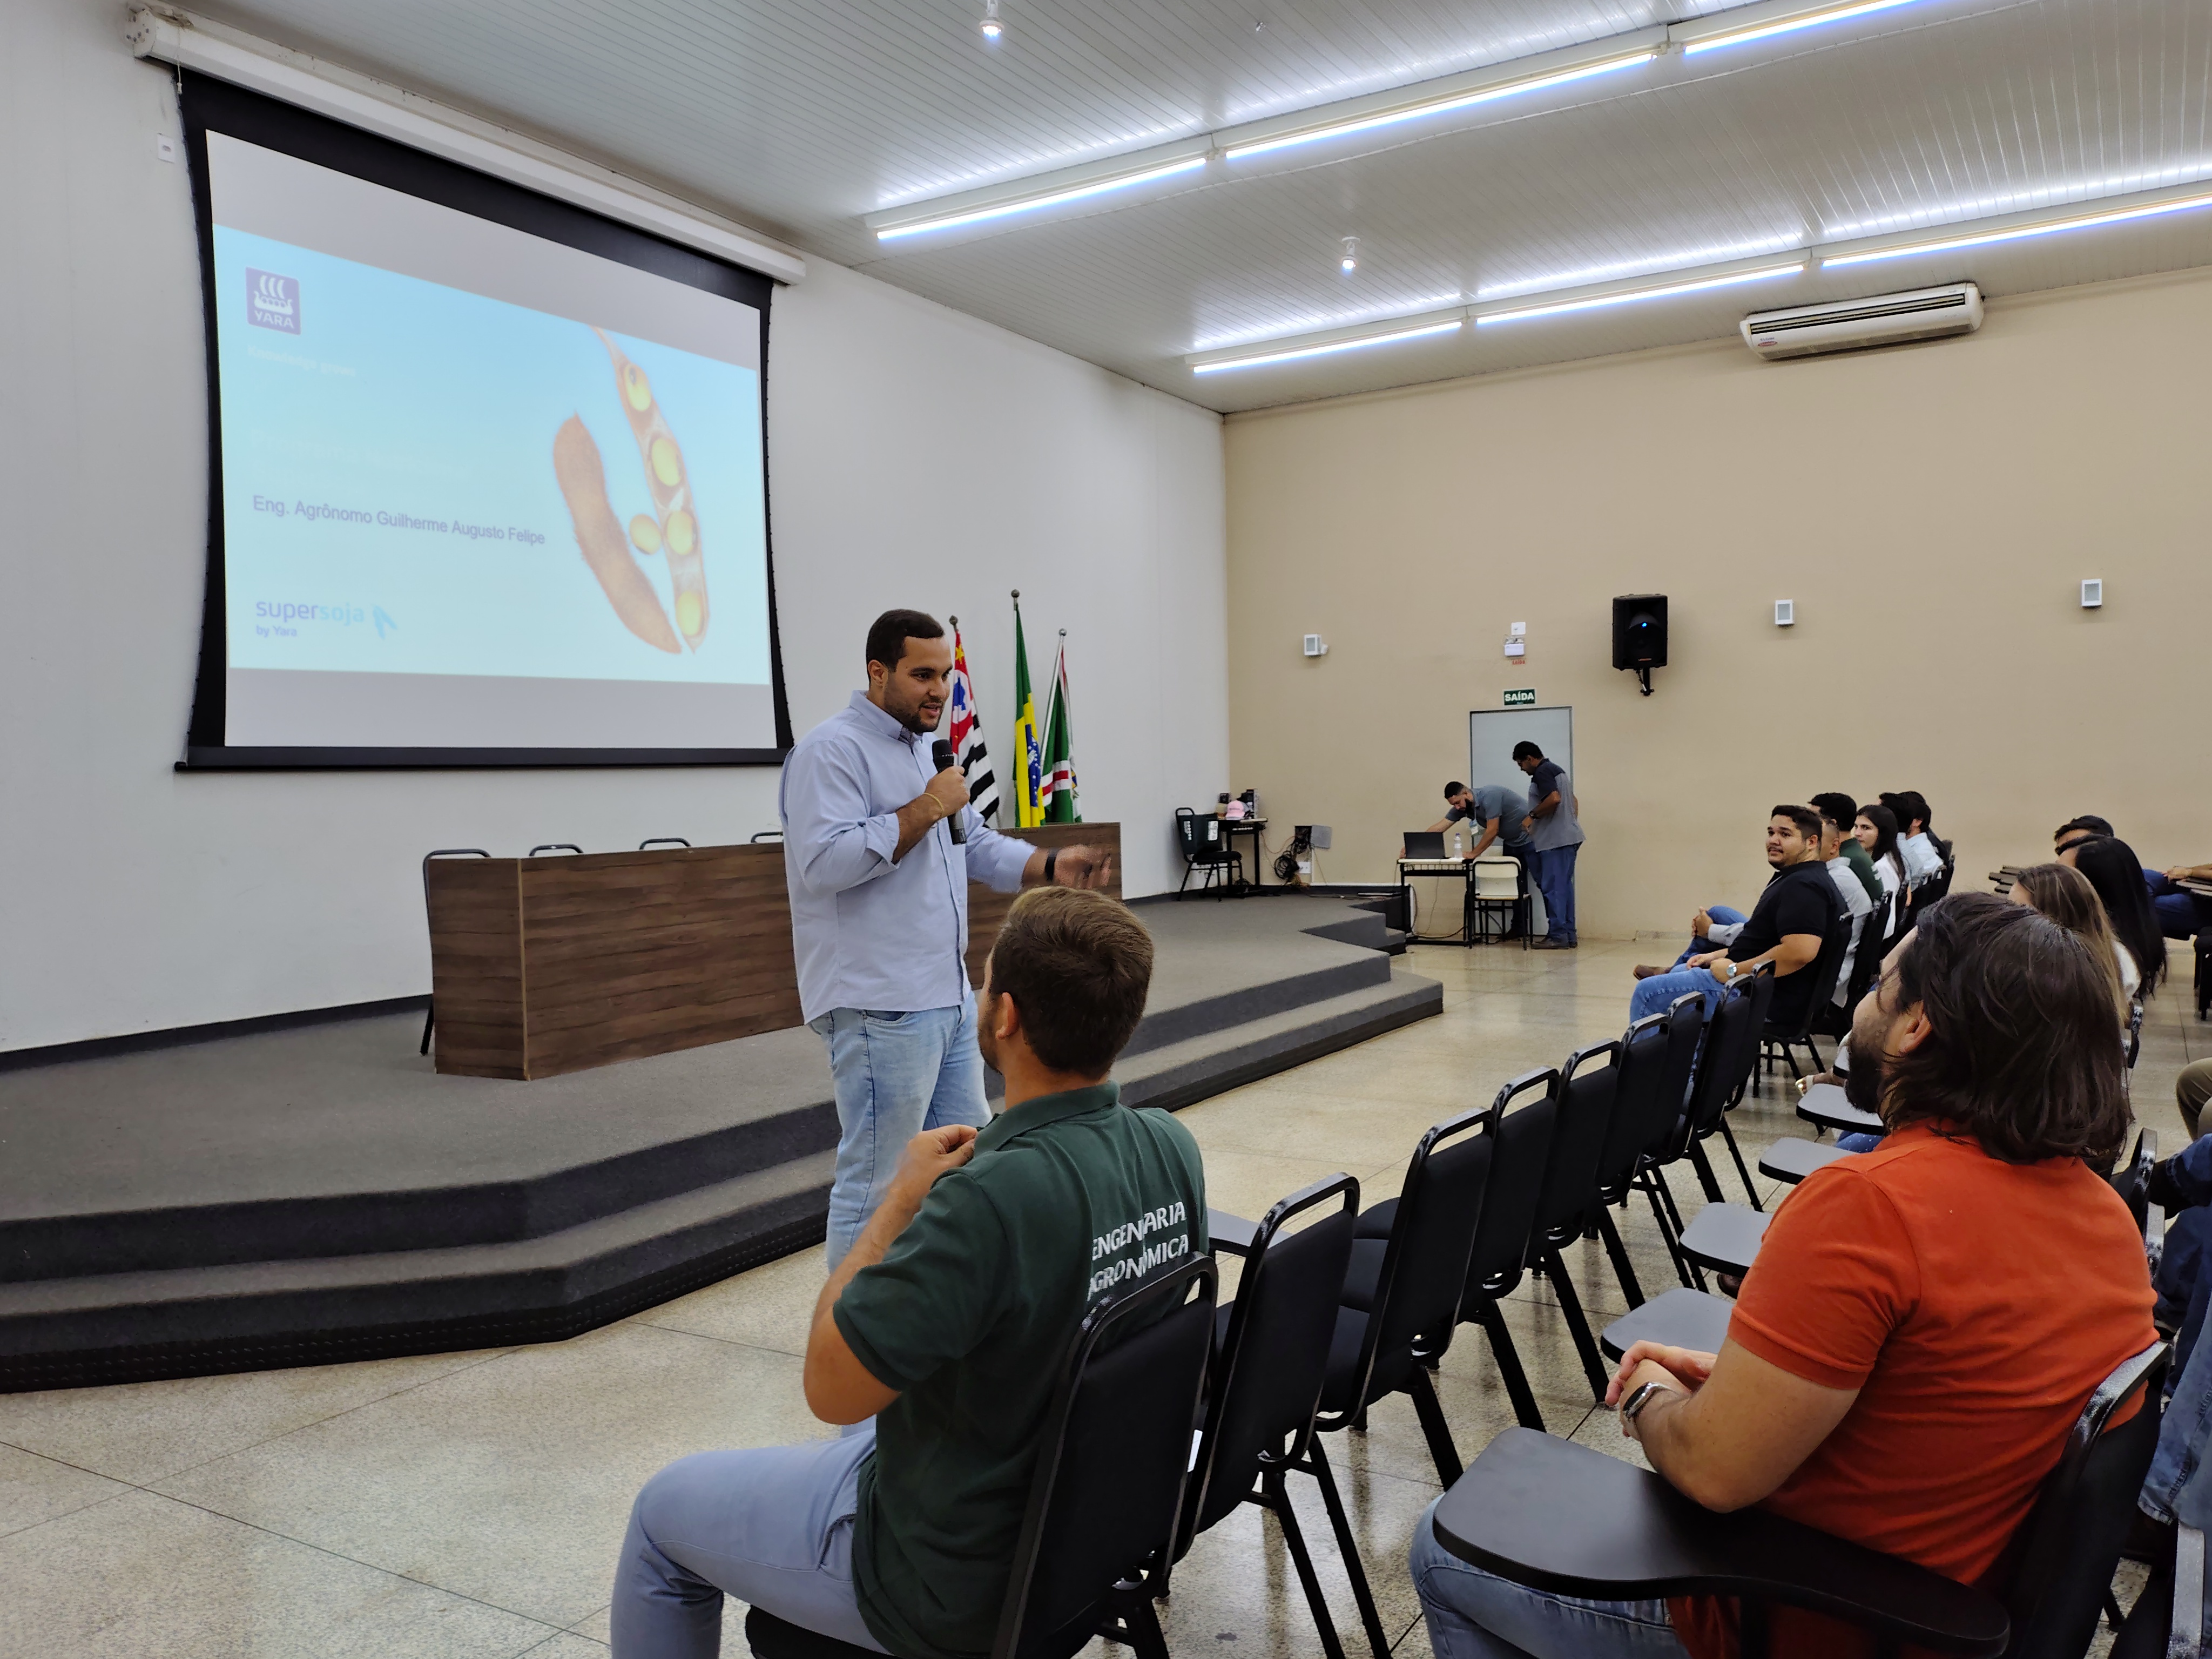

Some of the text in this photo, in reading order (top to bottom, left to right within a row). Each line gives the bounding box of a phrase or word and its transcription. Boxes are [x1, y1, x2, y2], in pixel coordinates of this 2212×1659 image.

[254, 310, 294, 329] YARA
[253, 495, 545, 547] Eng. Agrônomo Guilherme Augusto Felipe
[256, 624, 297, 638] by Yara
[1505, 691, 1534, 702] SAÍDA
[1092, 1201, 1187, 1261] ENGENARIA
